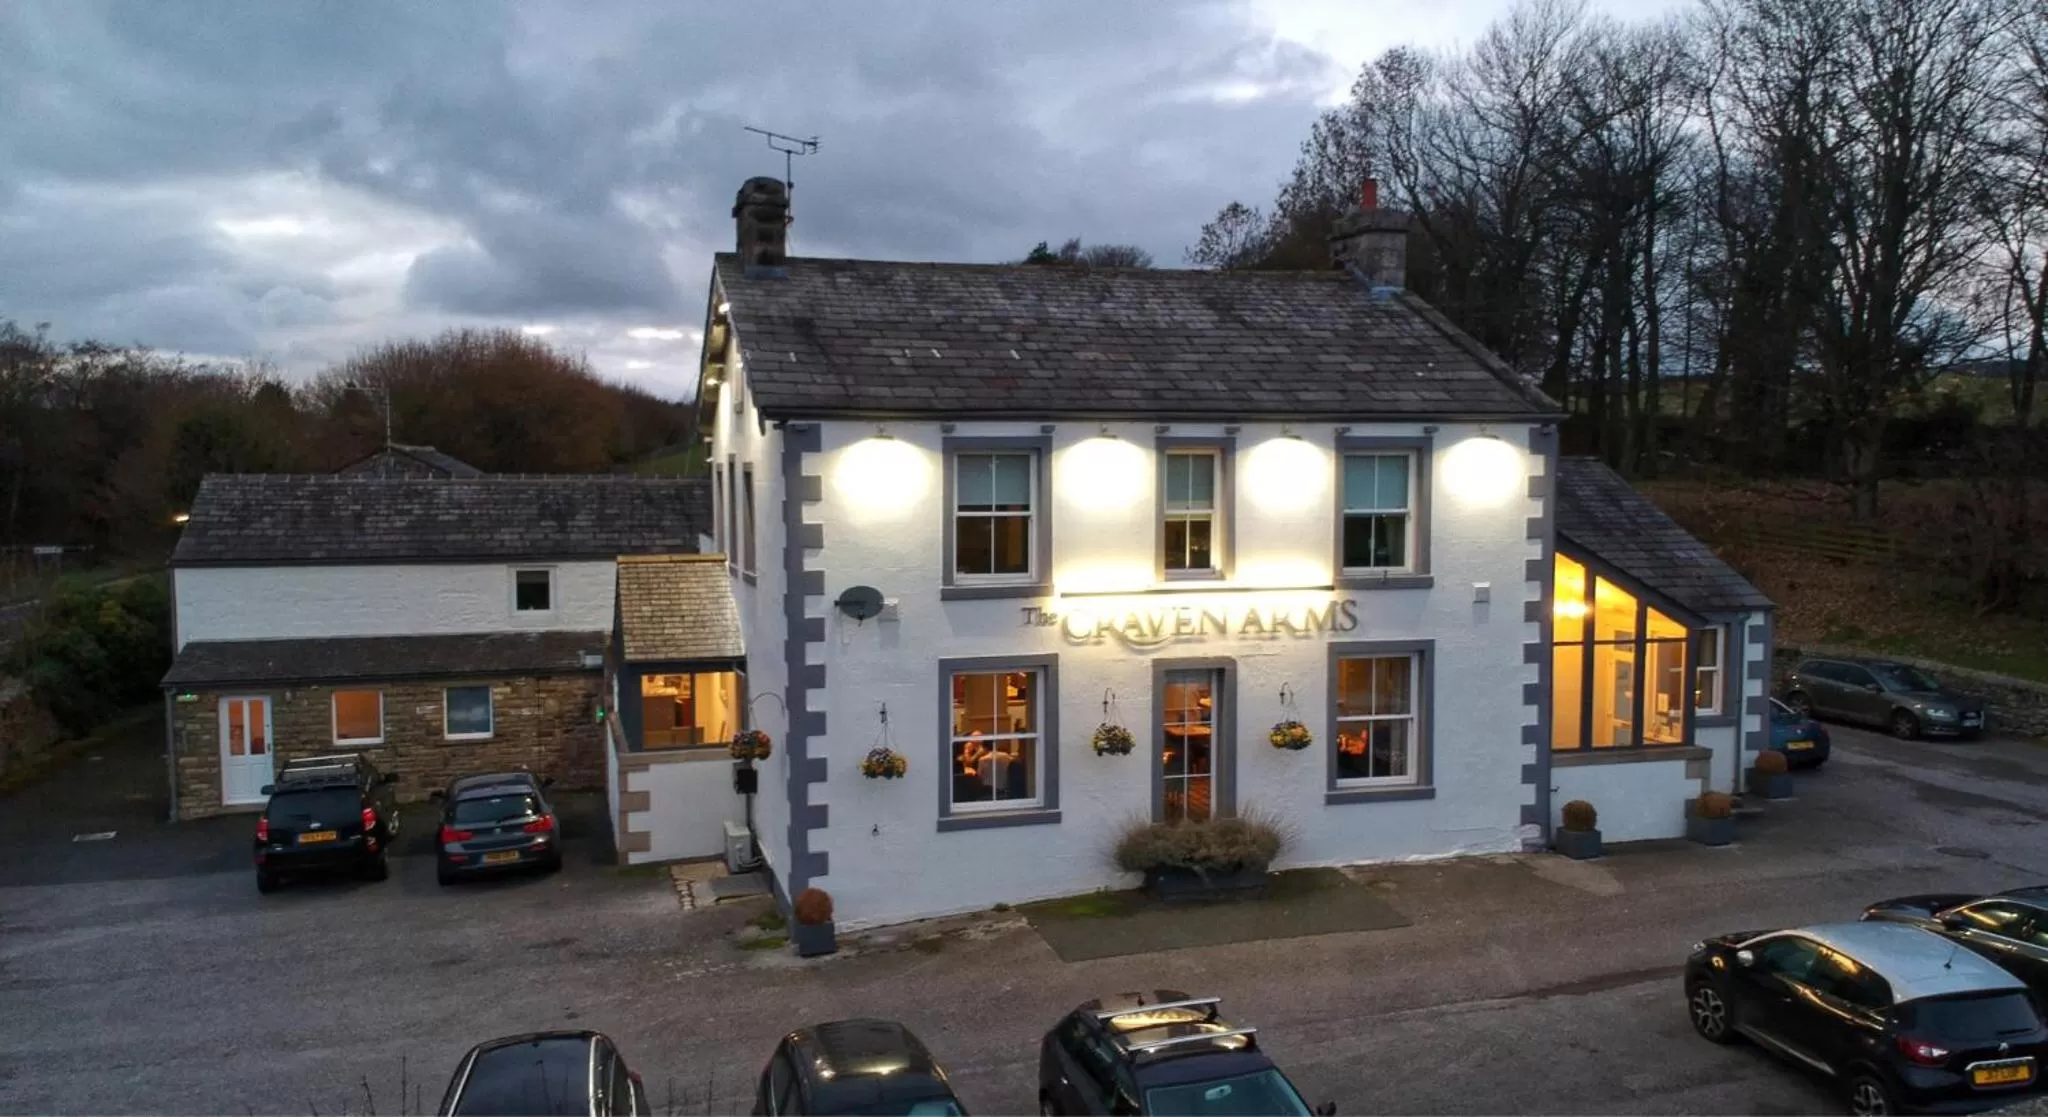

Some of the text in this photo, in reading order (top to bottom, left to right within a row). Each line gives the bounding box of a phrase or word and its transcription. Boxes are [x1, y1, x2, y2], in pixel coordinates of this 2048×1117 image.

[1021, 600, 1358, 647] The CRAVEN ARMS
